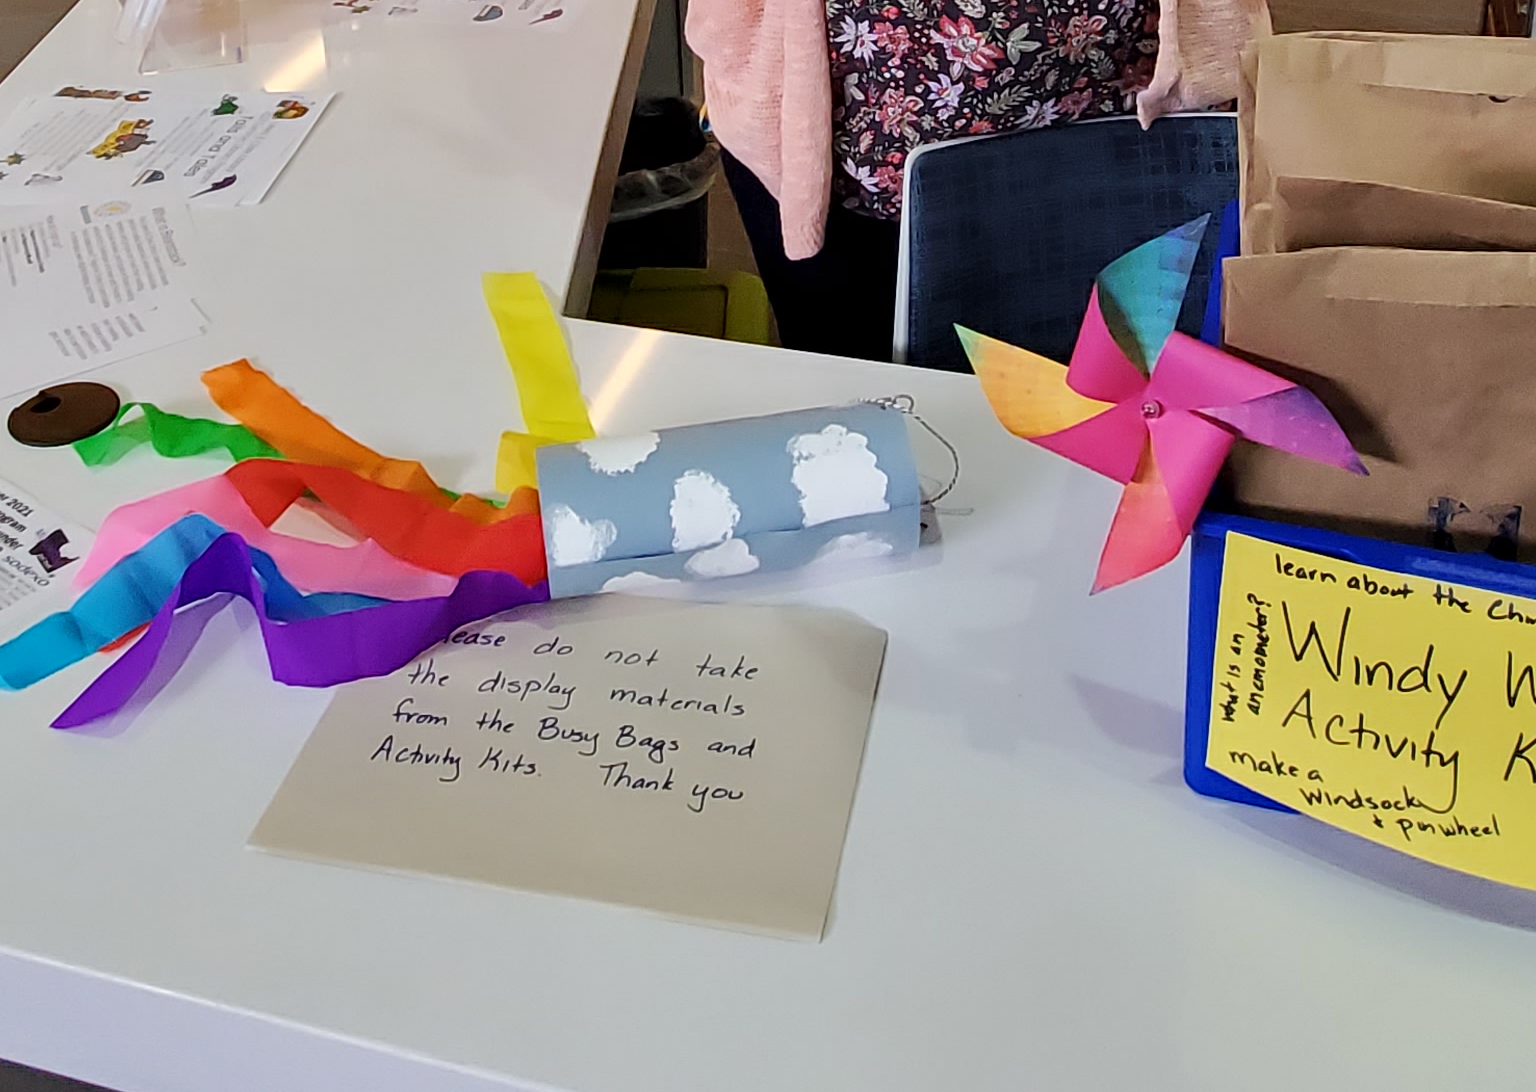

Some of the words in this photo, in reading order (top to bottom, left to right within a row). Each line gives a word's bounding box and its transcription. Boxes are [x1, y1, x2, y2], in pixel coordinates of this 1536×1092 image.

[7, 497, 35, 518] 2021
[1275, 553, 1337, 583] learn
[1347, 573, 1414, 599] about
[1432, 584, 1472, 613] the
[442, 630, 507, 648] ease
[533, 636, 574, 657] do
[604, 649, 661, 667] not
[696, 654, 759, 681] take
[1281, 600, 1468, 730] Windy
[407, 658, 450, 687] the
[477, 670, 577, 710] display
[610, 688, 745, 717] materials
[392, 698, 448, 727] from
[476, 709, 515, 734] the
[537, 717, 600, 756] Busy
[615, 725, 680, 764] Bags
[707, 738, 757, 759] and
[1281, 688, 1460, 814] Activity
[370, 735, 462, 782] Activity
[477, 746, 542, 777] Kits.
[599, 761, 674, 792] Thank
[686, 782, 744, 813] you
[1229, 751, 1298, 777] make
[1307, 769, 1324, 783] a
